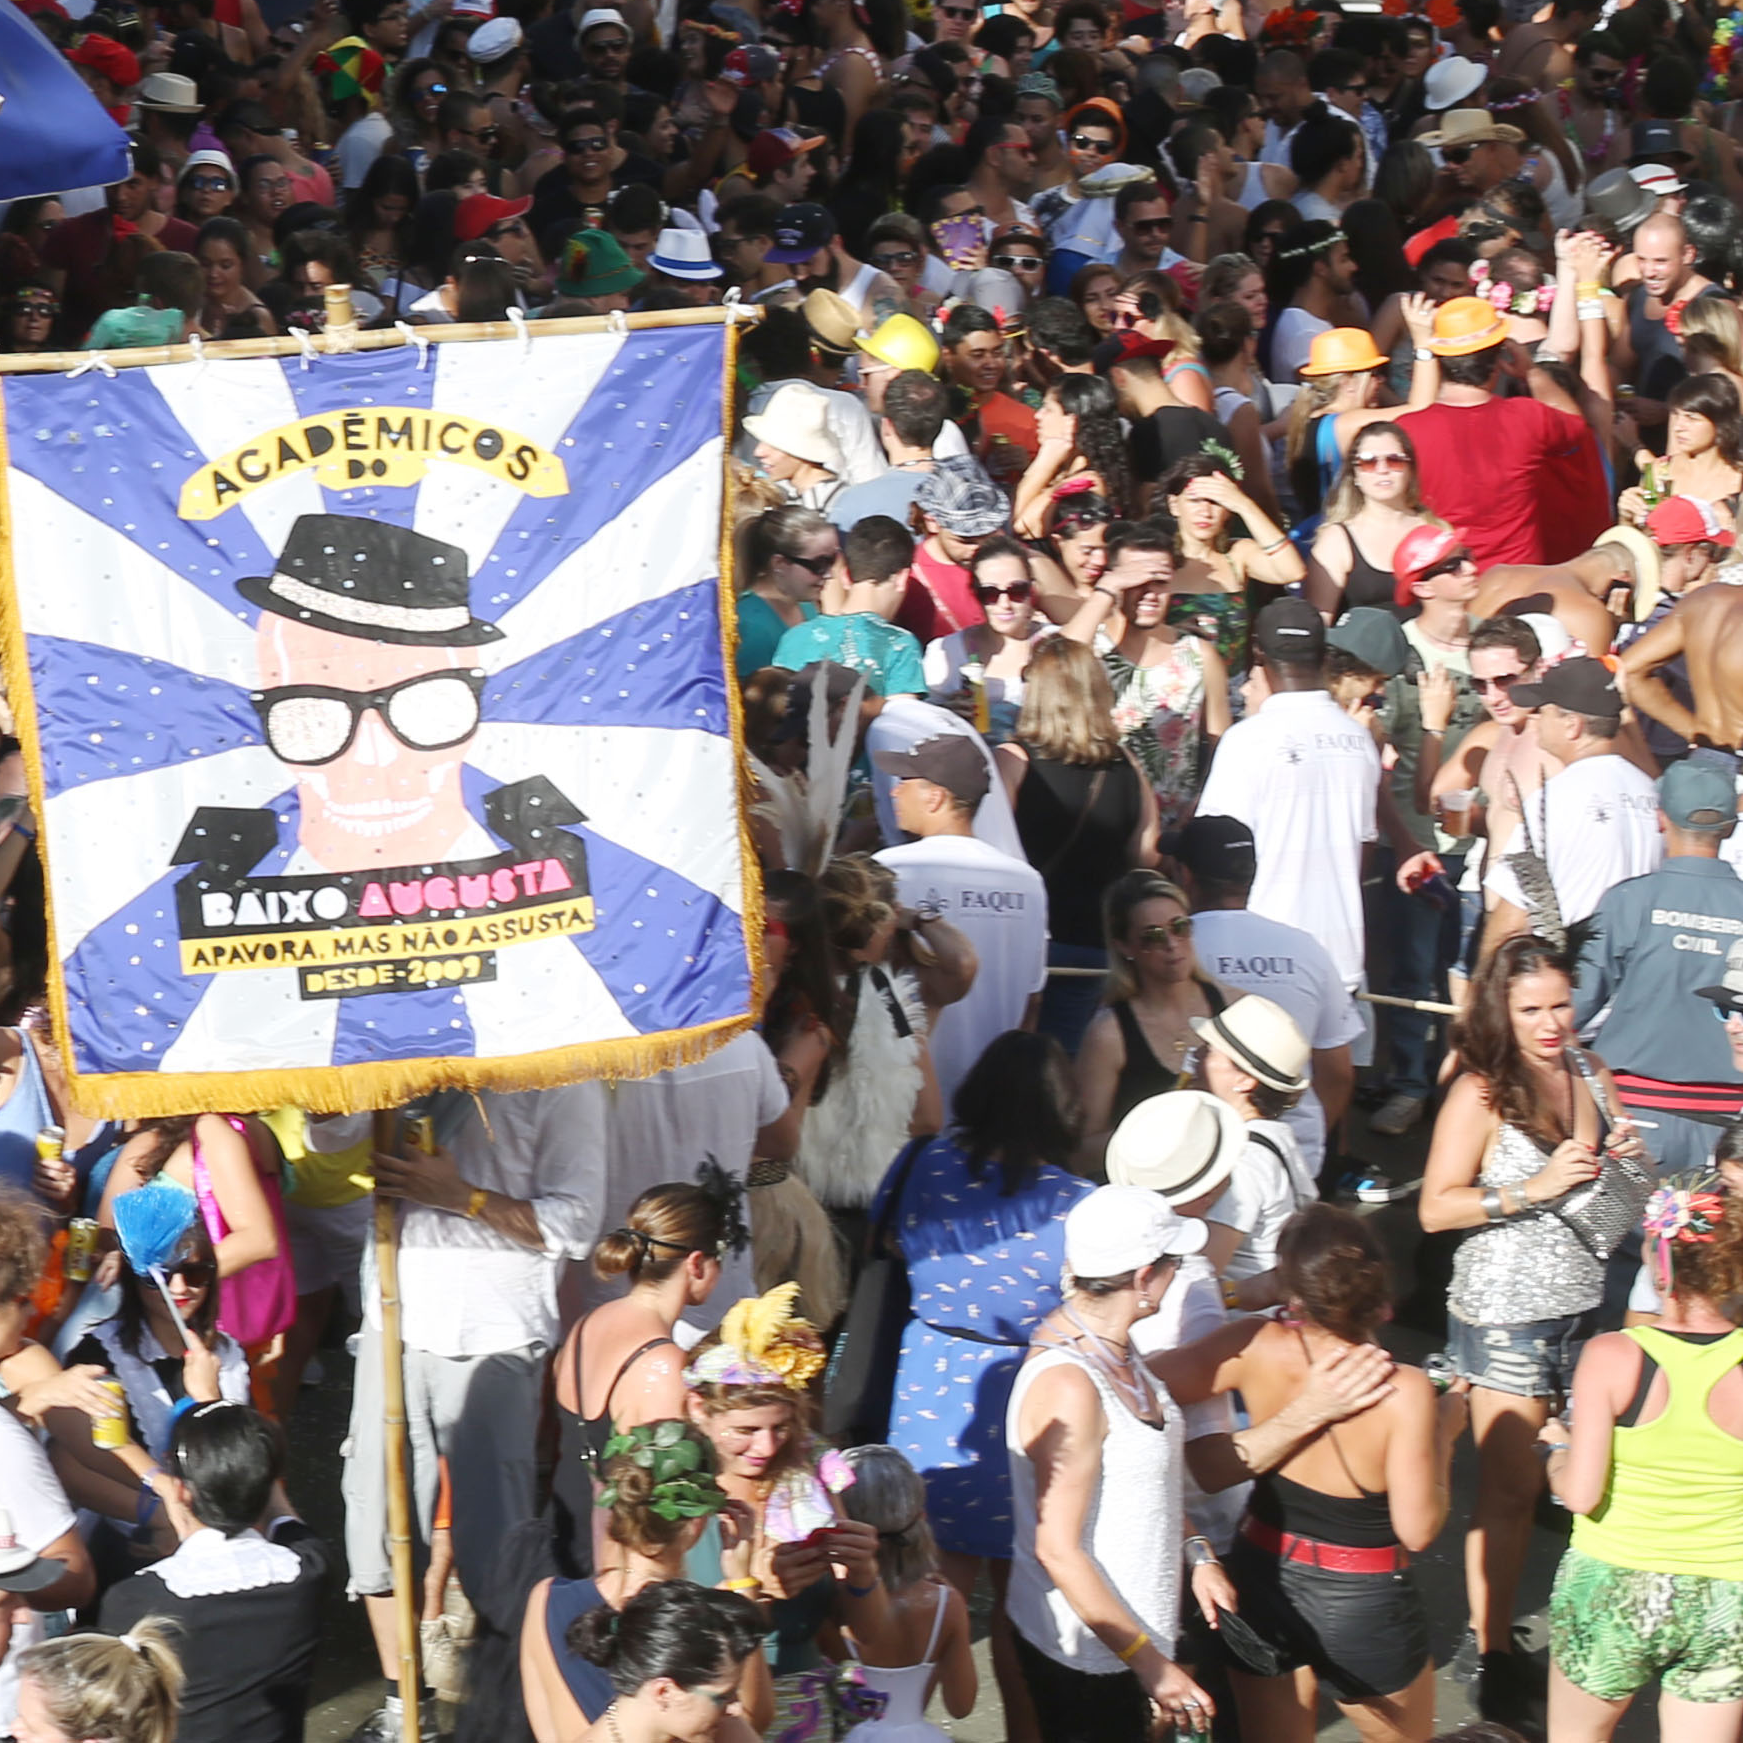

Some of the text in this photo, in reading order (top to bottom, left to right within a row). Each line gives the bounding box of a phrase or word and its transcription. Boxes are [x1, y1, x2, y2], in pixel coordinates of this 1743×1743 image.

[211, 412, 539, 507] ACADÊMICOS
[346, 458, 387, 480] DO
[201, 857, 573, 928] BAIXO AUGUSTA
[961, 890, 1025, 913] FAQUI
[331, 932, 392, 959] MAS
[401, 926, 460, 954] NÃO
[1672, 934, 1724, 956] CIVIL
[1218, 956, 1296, 978] FAQUI
